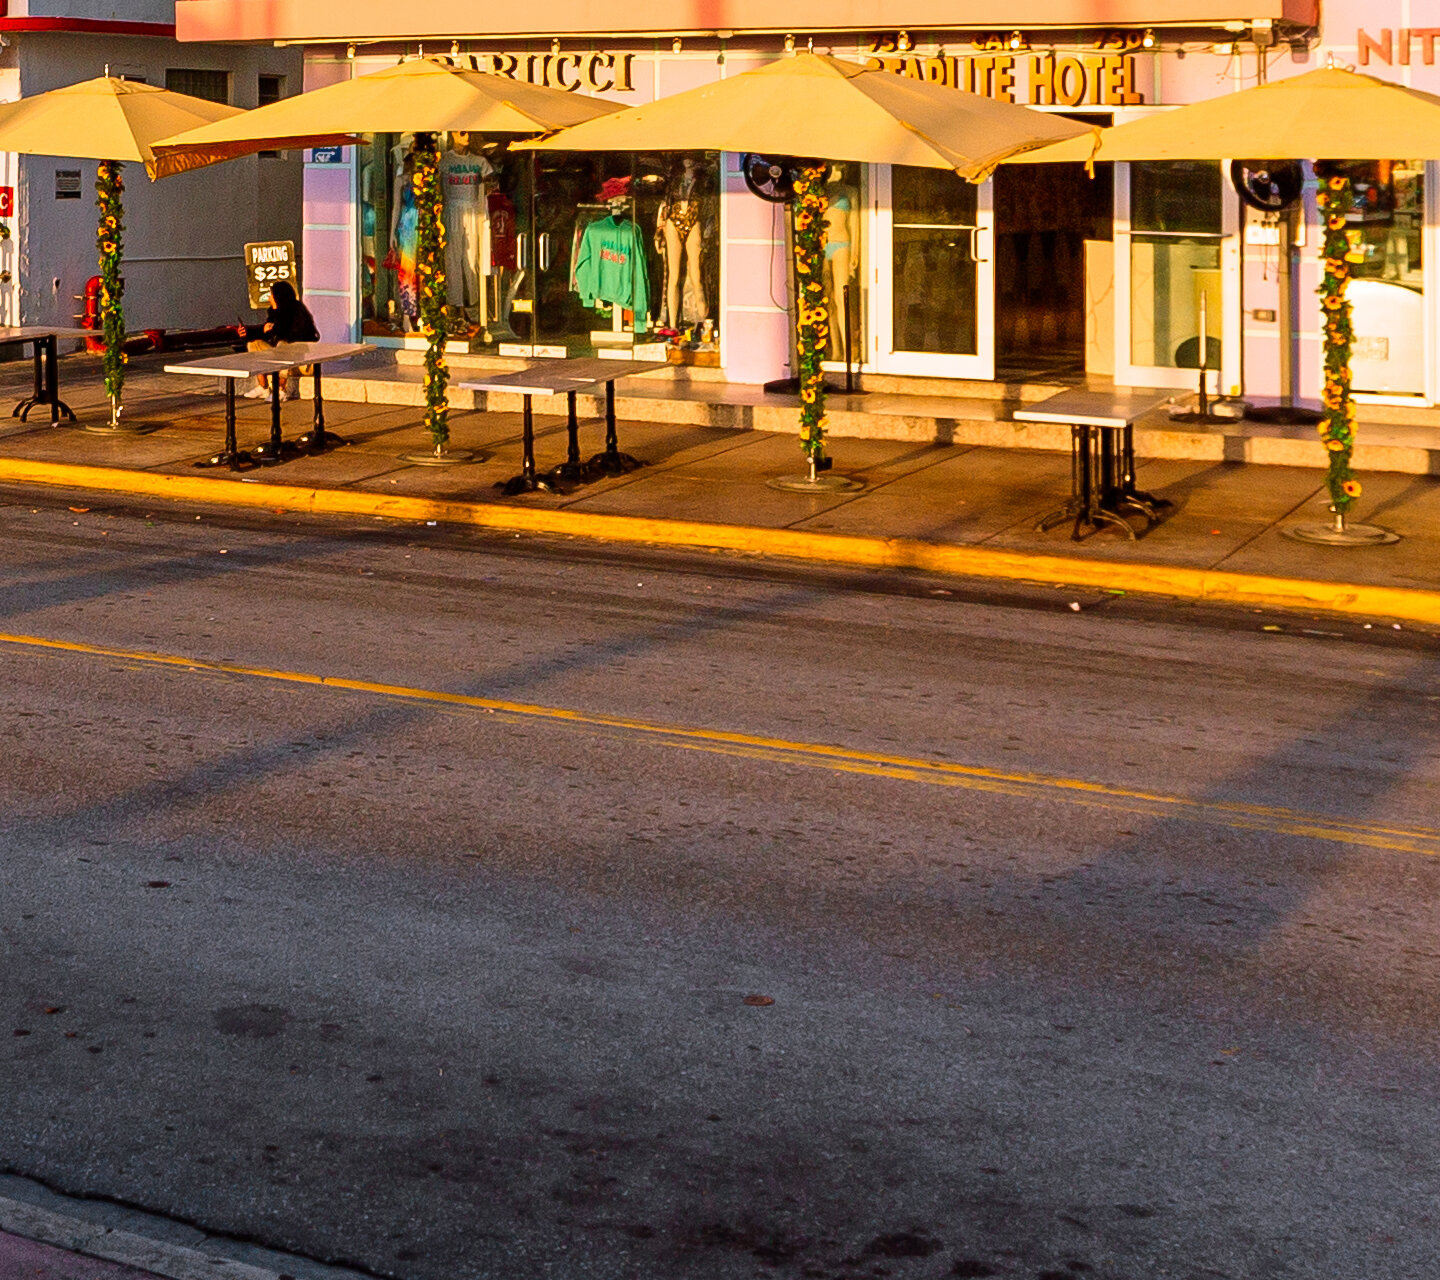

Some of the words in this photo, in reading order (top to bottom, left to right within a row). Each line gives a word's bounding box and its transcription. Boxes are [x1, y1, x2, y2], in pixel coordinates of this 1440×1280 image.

[1029, 56, 1144, 107] HOTEL
[252, 245, 288, 263] PARKING
[254, 266, 289, 281] $25
